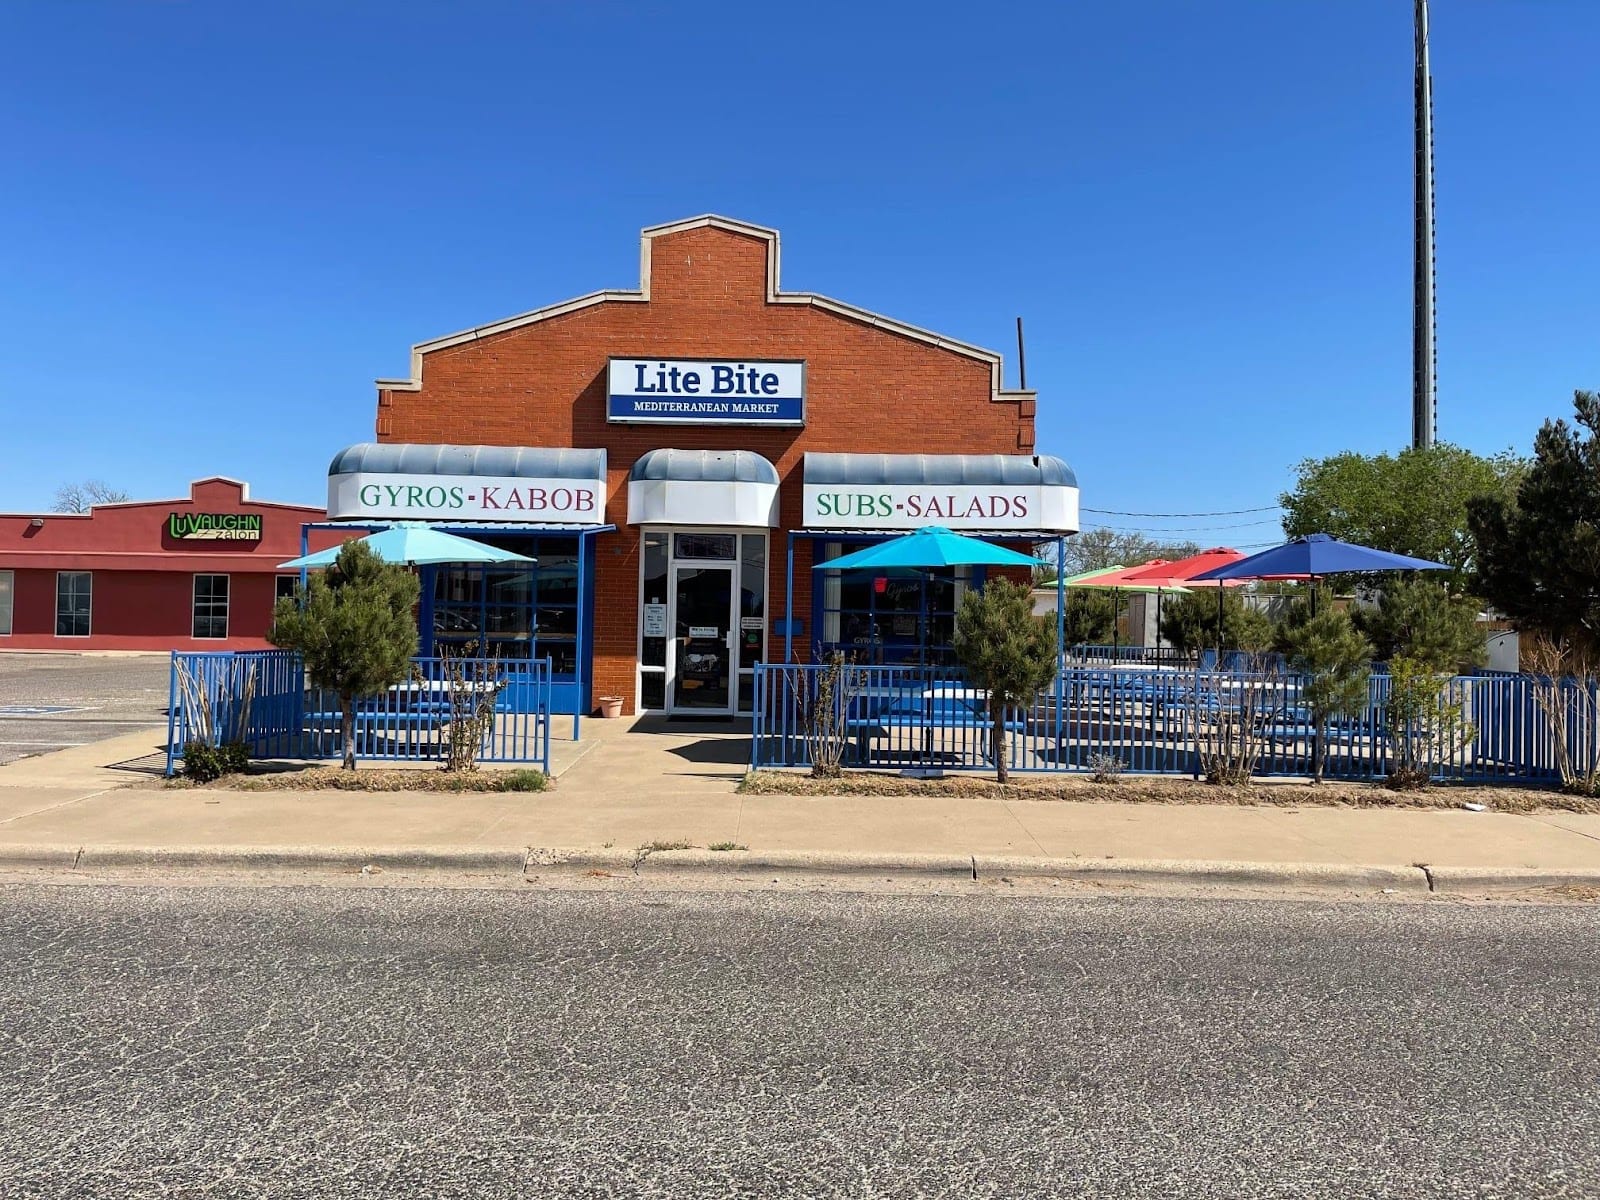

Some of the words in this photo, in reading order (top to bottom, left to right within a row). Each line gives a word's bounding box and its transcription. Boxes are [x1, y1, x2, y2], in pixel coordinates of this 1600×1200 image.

[634, 363, 700, 393] Lite
[710, 364, 779, 394] Bite
[634, 401, 729, 412] MEDITERRANEAN
[732, 403, 779, 413] MARKET
